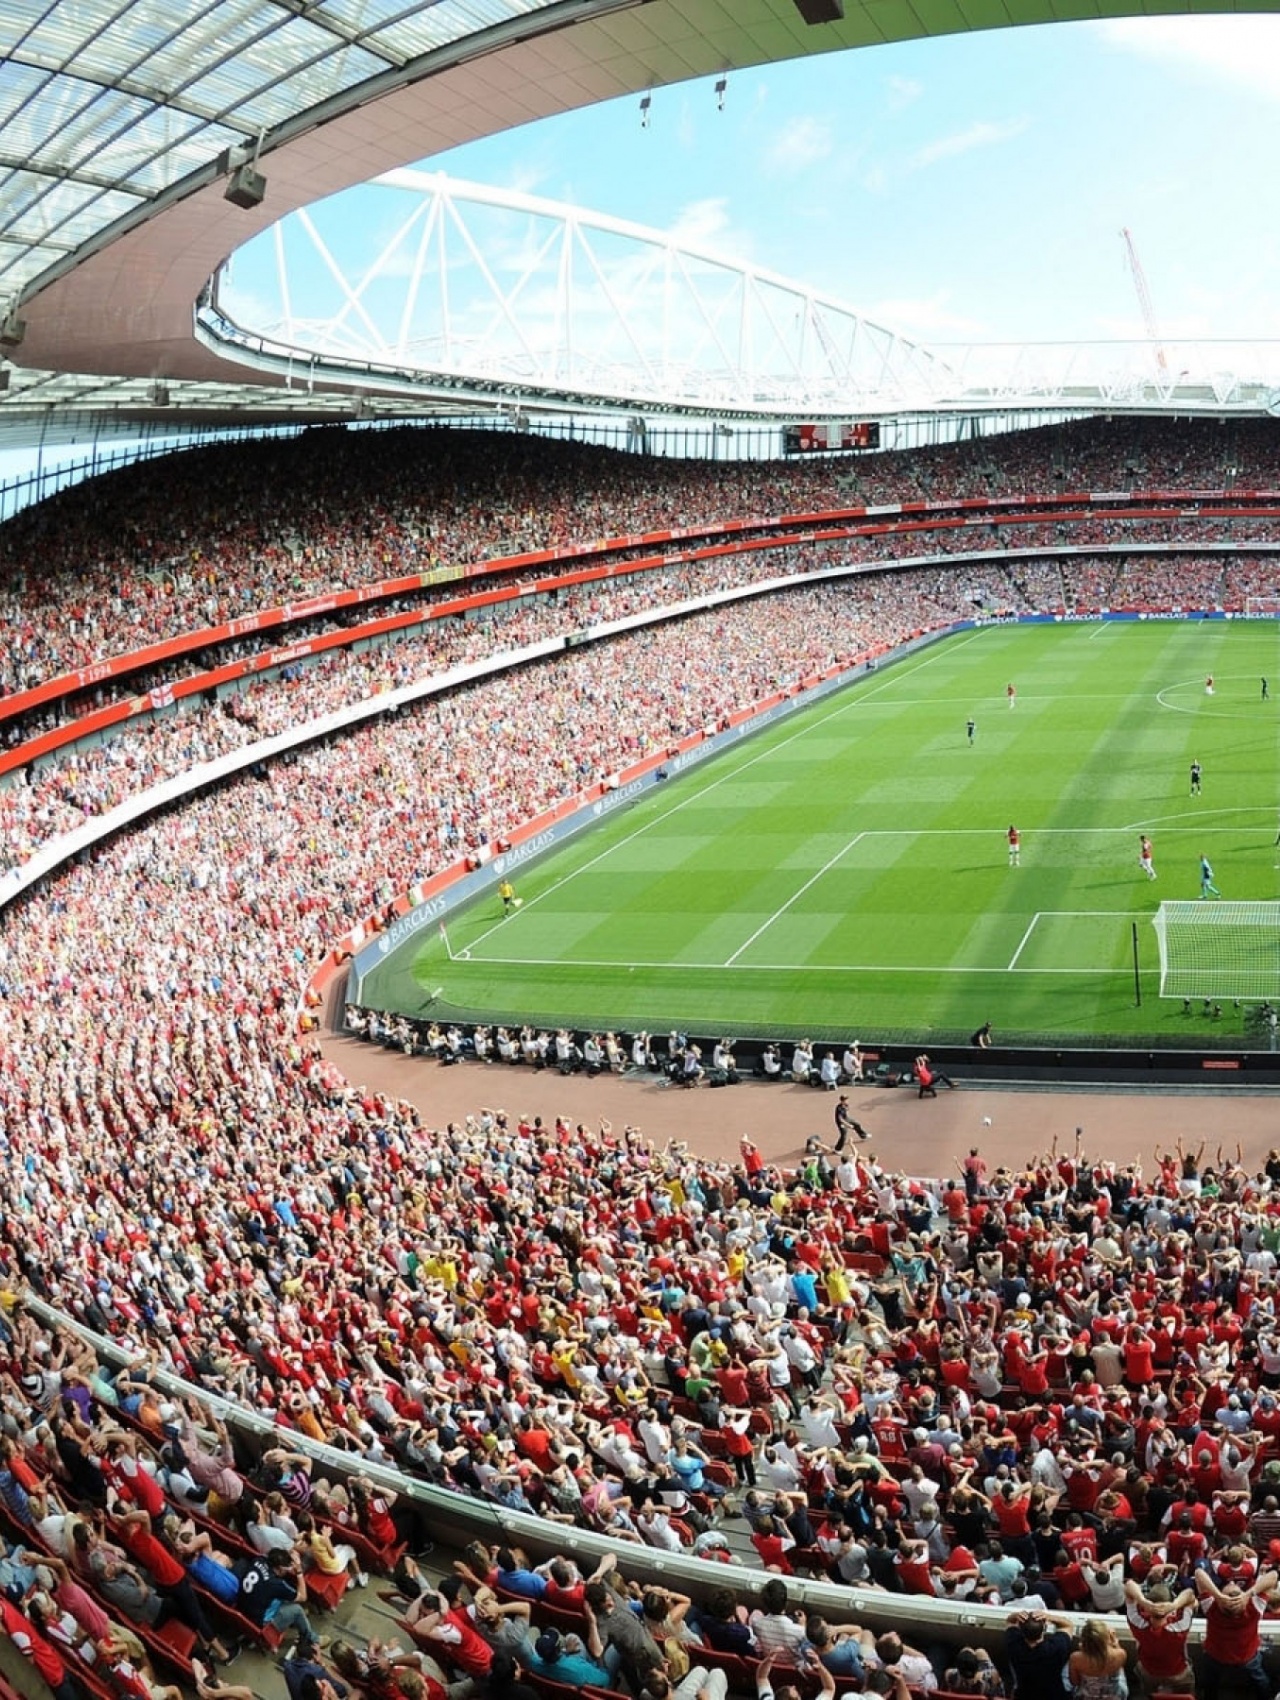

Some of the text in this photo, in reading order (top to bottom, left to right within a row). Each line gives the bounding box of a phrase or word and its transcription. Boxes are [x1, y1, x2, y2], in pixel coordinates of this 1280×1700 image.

[1064, 613, 1103, 621] BARCLAYS
[602, 779, 644, 810] BARCLAYS
[505, 829, 555, 866] BARCLAYS
[390, 895, 447, 943] BARCLAYS
[1074, 1547, 1092, 1562] 10
[243, 1571, 259, 1593] 8
